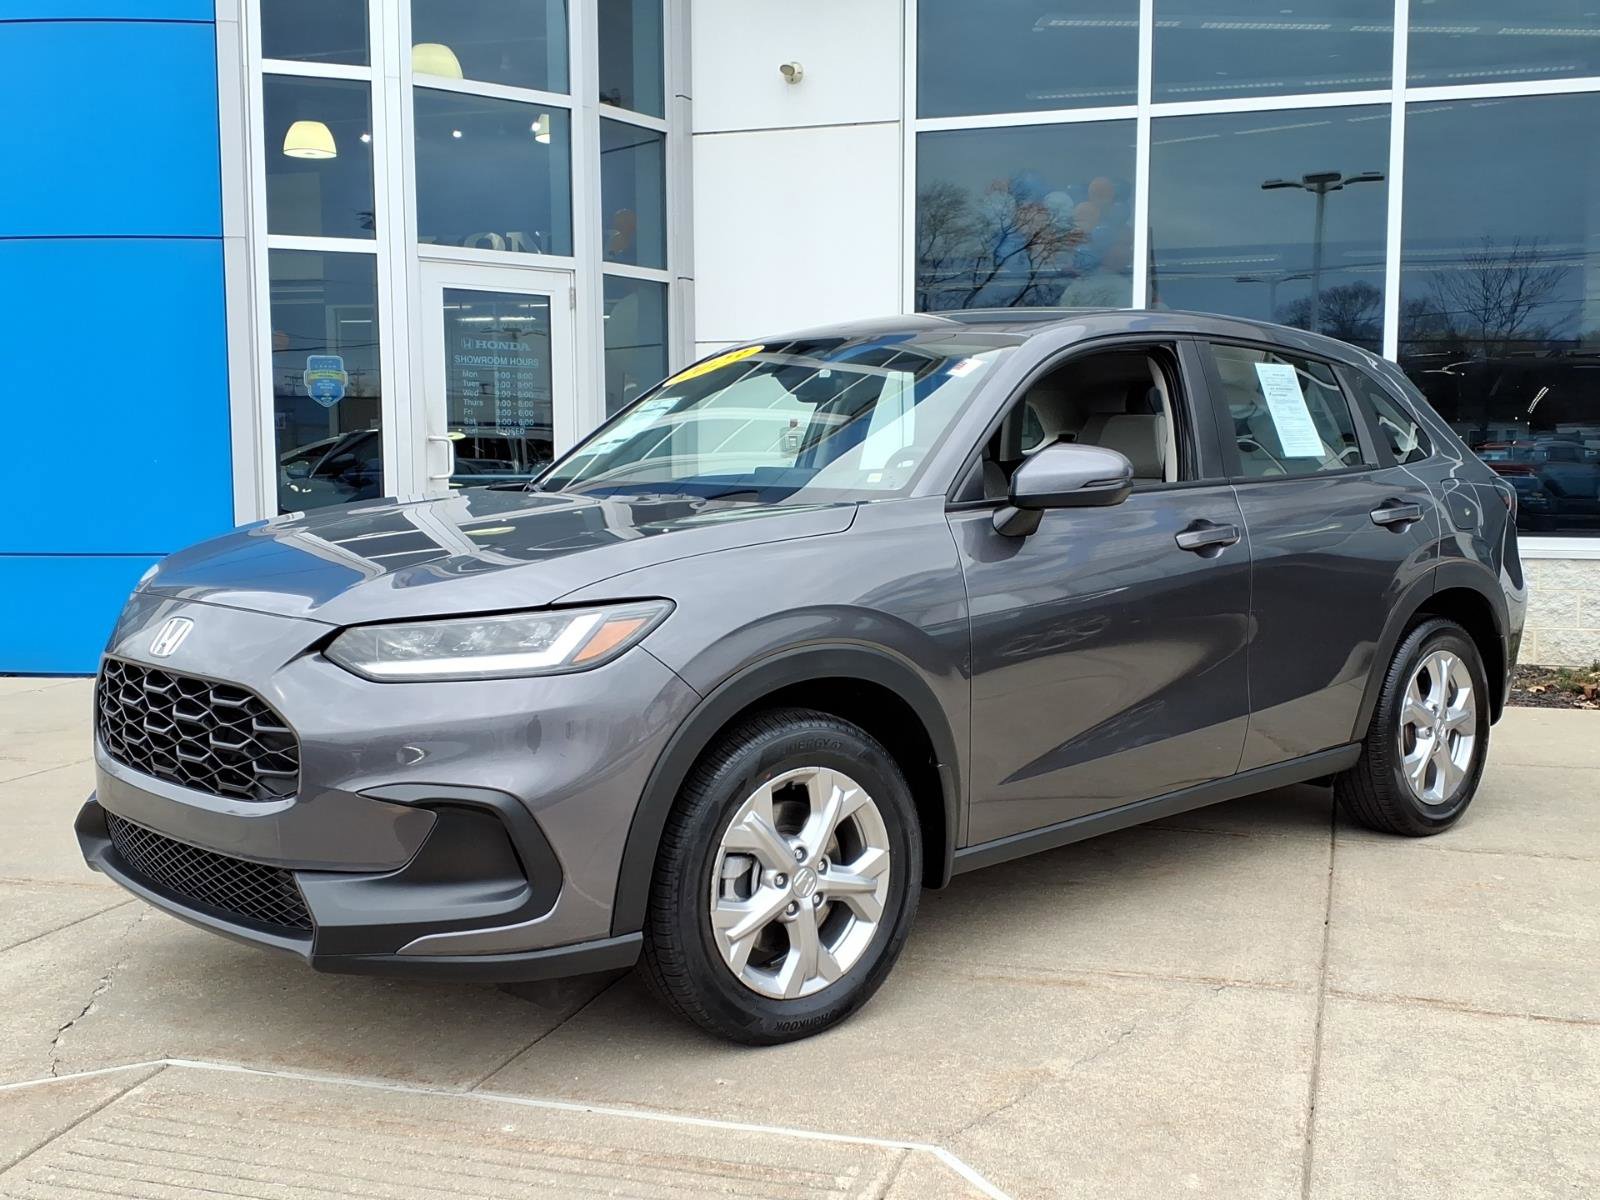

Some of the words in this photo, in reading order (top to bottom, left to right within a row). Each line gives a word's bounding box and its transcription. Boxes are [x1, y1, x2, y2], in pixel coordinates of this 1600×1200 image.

[475, 340, 532, 352] HONDA
[454, 354, 508, 365] SHOWROOM
[509, 357, 539, 368] HOURS
[462, 370, 478, 378] Mon
[463, 379, 480, 387] Tues
[462, 389, 479, 397] Wed
[464, 399, 484, 407] Thurs
[464, 417, 476, 425] Sat
